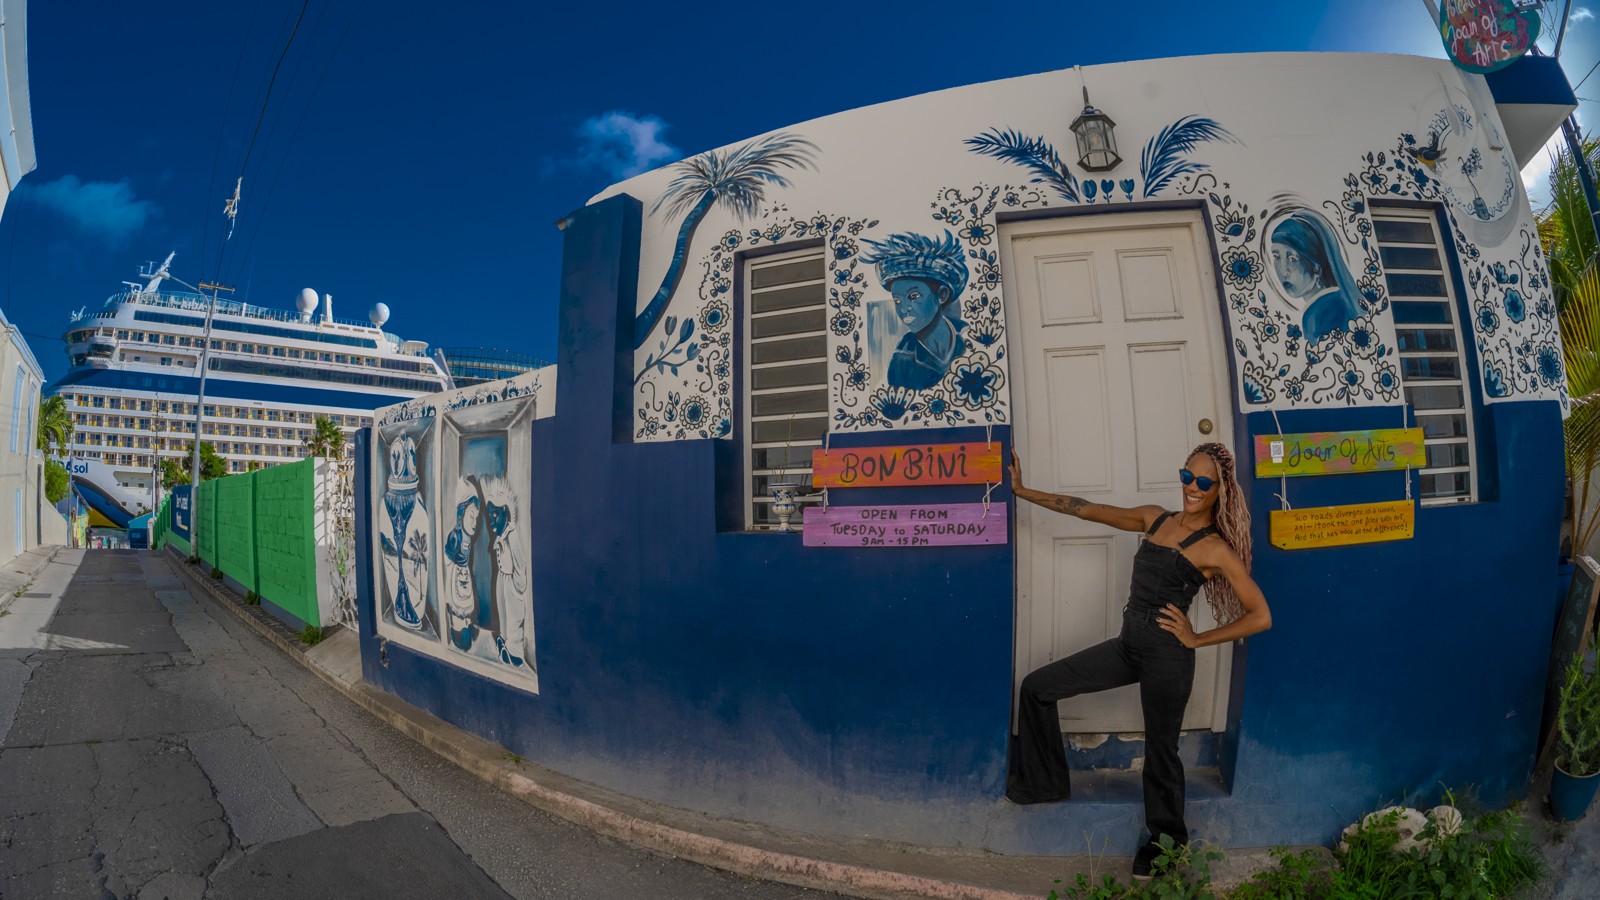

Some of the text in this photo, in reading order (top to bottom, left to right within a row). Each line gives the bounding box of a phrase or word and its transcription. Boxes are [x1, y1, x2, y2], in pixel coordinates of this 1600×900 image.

[861, 509, 948, 520] OPEN FROM
[1311, 511, 1333, 520] roads
[893, 527, 905, 535] to
[913, 522, 987, 537] SATURDAY
[1309, 531, 1324, 539] that
